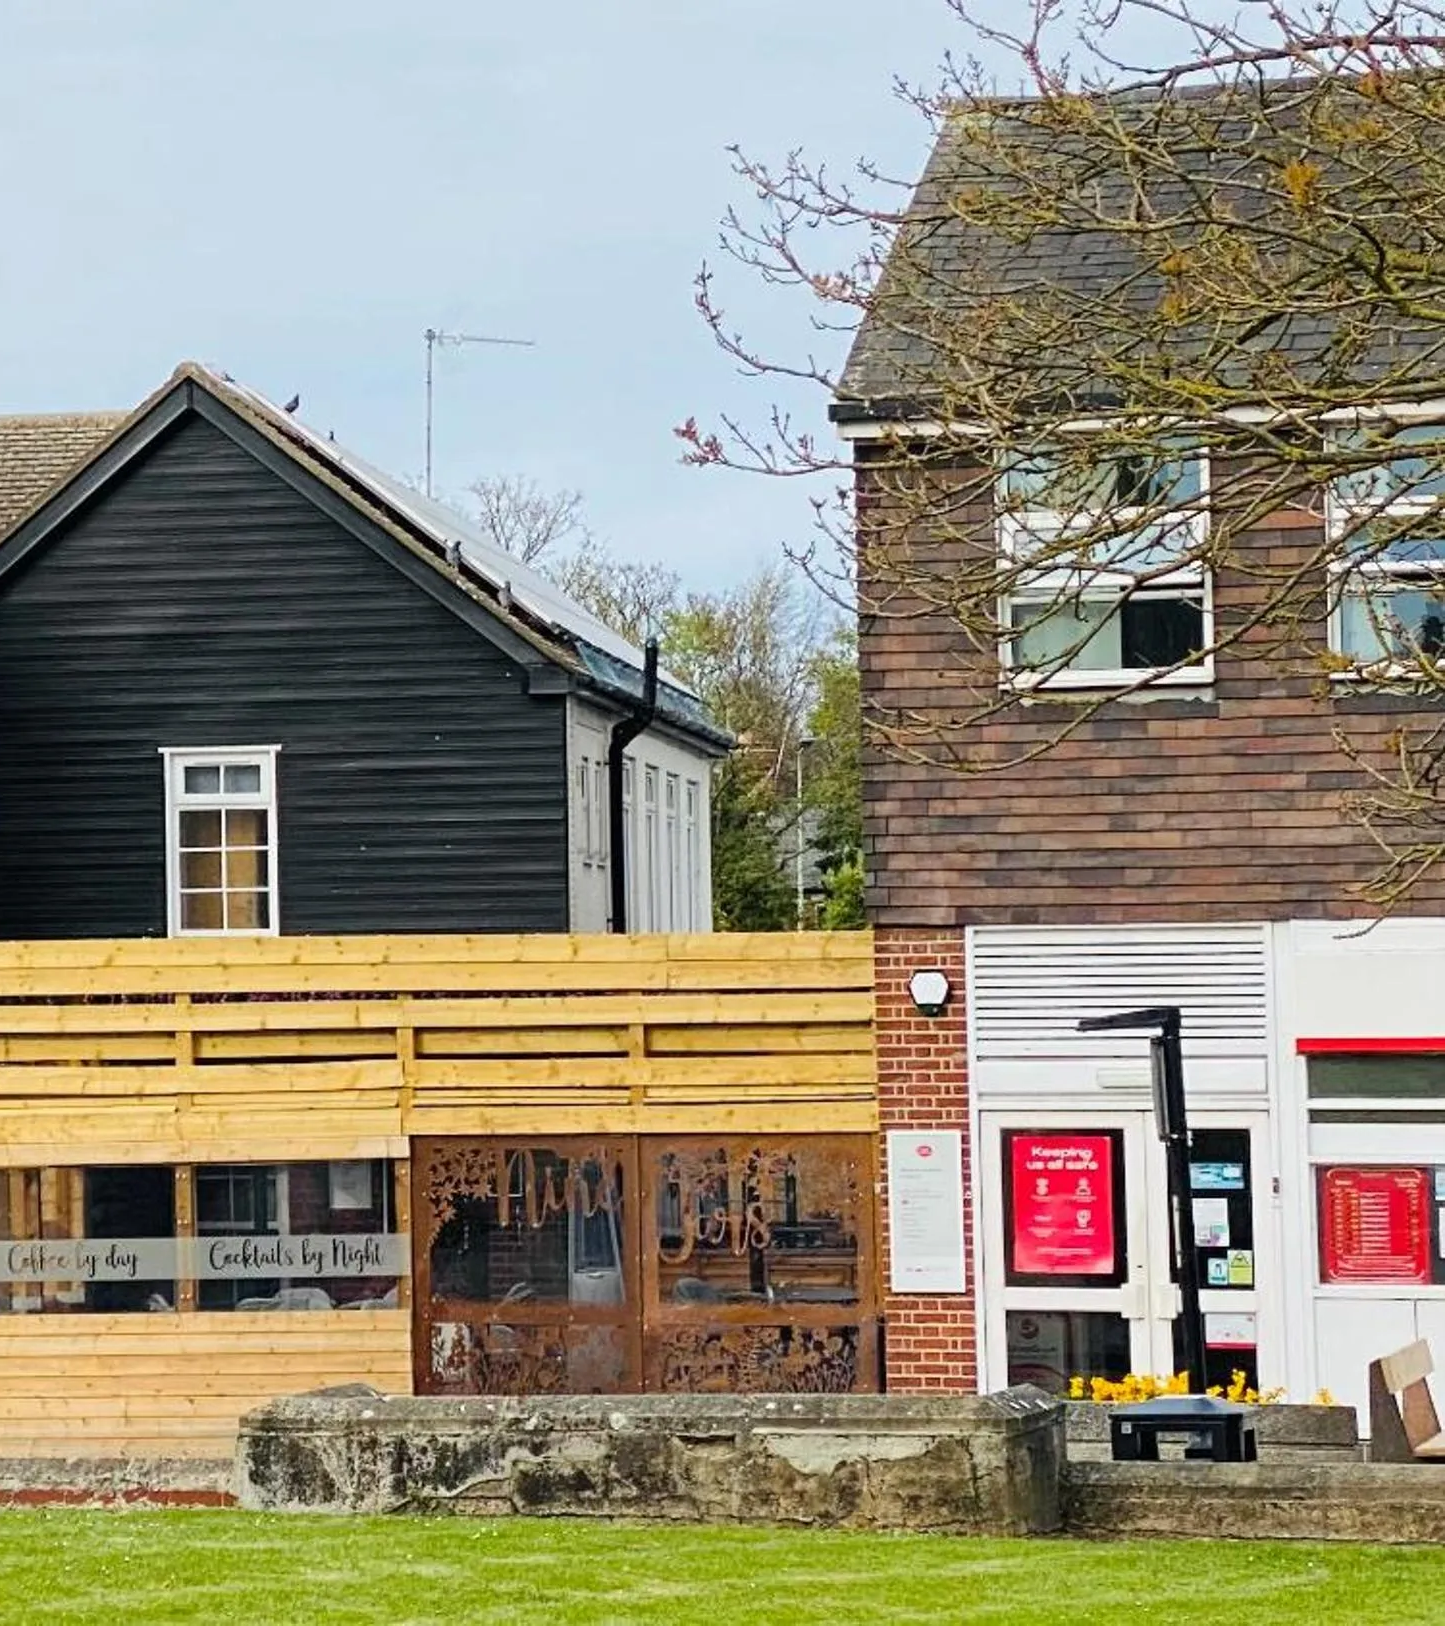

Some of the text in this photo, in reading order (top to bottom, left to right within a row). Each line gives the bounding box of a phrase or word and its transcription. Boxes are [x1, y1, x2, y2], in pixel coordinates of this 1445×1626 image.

[1026, 1159, 1099, 1170] us all safe
[1031, 1146, 1093, 1161] Keeping
[8, 1241, 139, 1278] Coffee by day
[209, 1236, 383, 1274] Cocktails by Night
